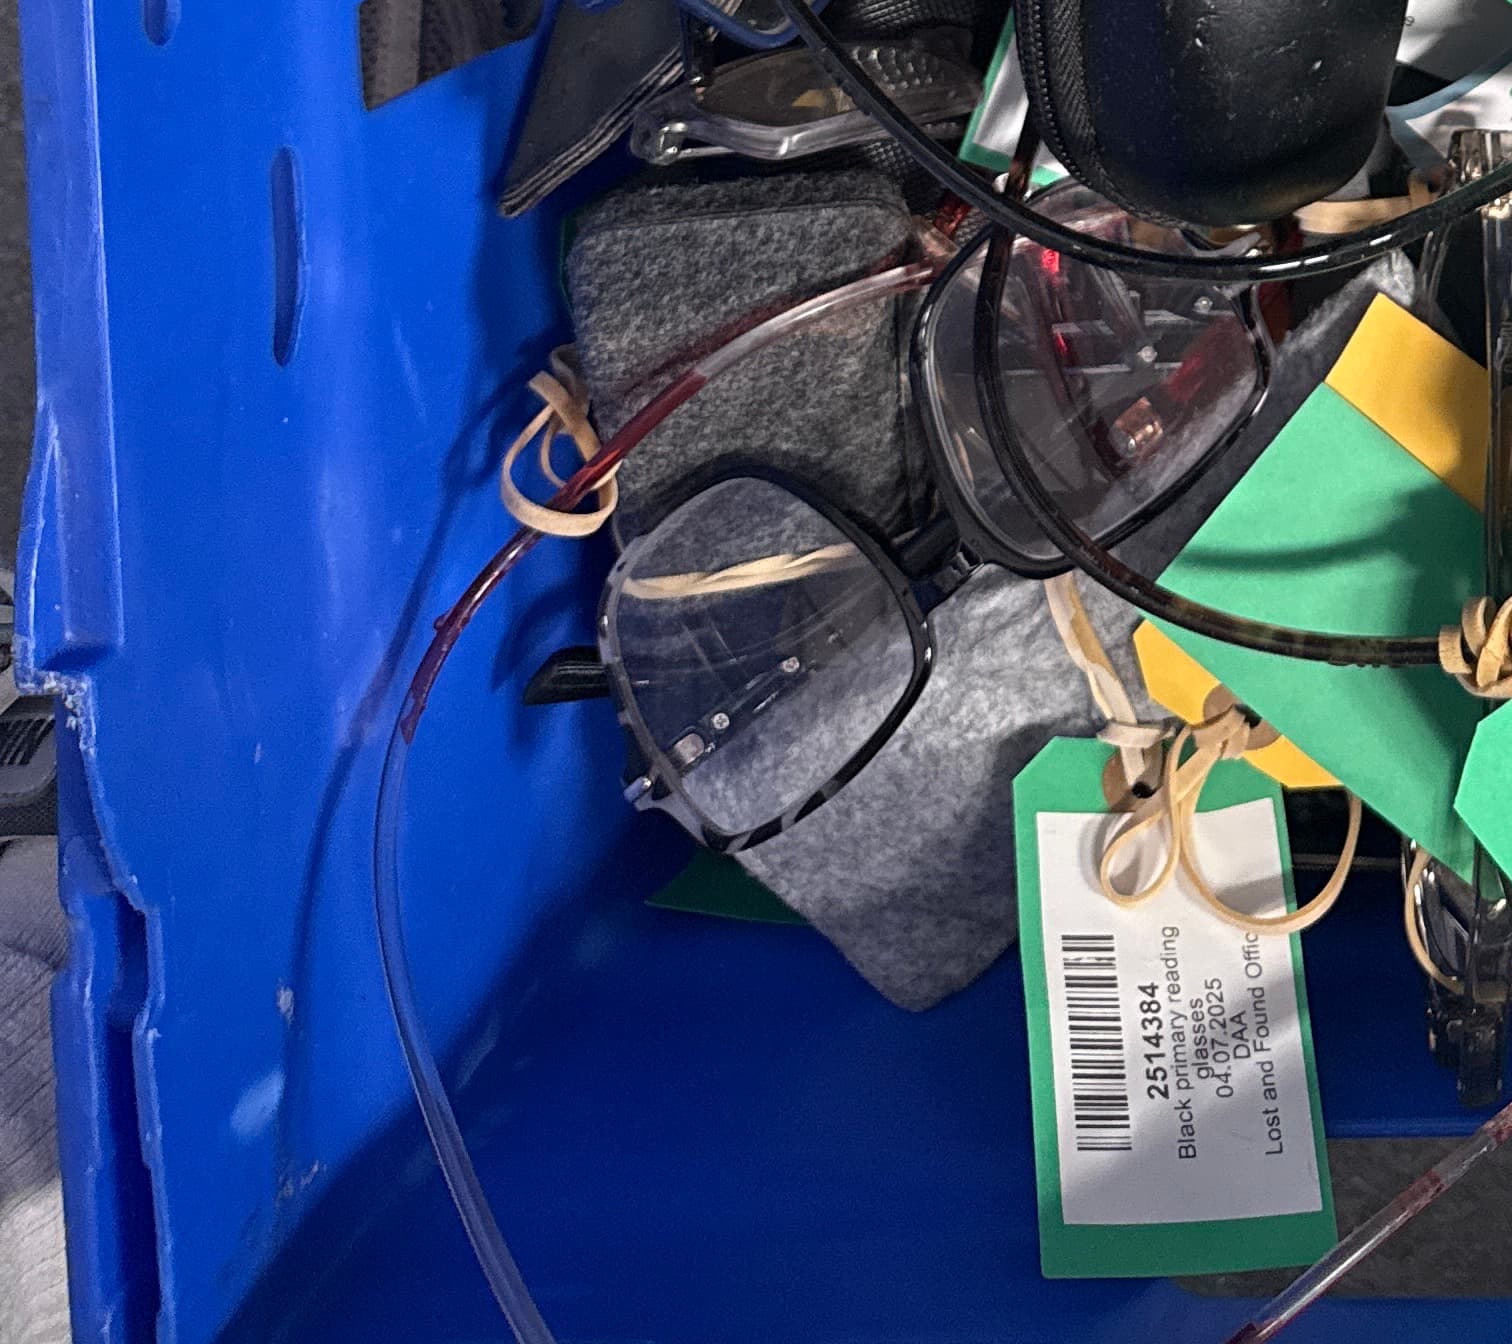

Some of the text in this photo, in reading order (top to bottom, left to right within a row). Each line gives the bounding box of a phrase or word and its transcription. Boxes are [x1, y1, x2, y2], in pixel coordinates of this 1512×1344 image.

[1137, 982, 1169, 1099] 2514384
[1161, 926, 1196, 1159] Black primary reading
[1189, 997, 1213, 1079] glasses
[1204, 977, 1233, 1098] 04.07.2025
[1229, 1009, 1251, 1059] DAA
[1242, 930, 1283, 1155] Lost and Found Offic
